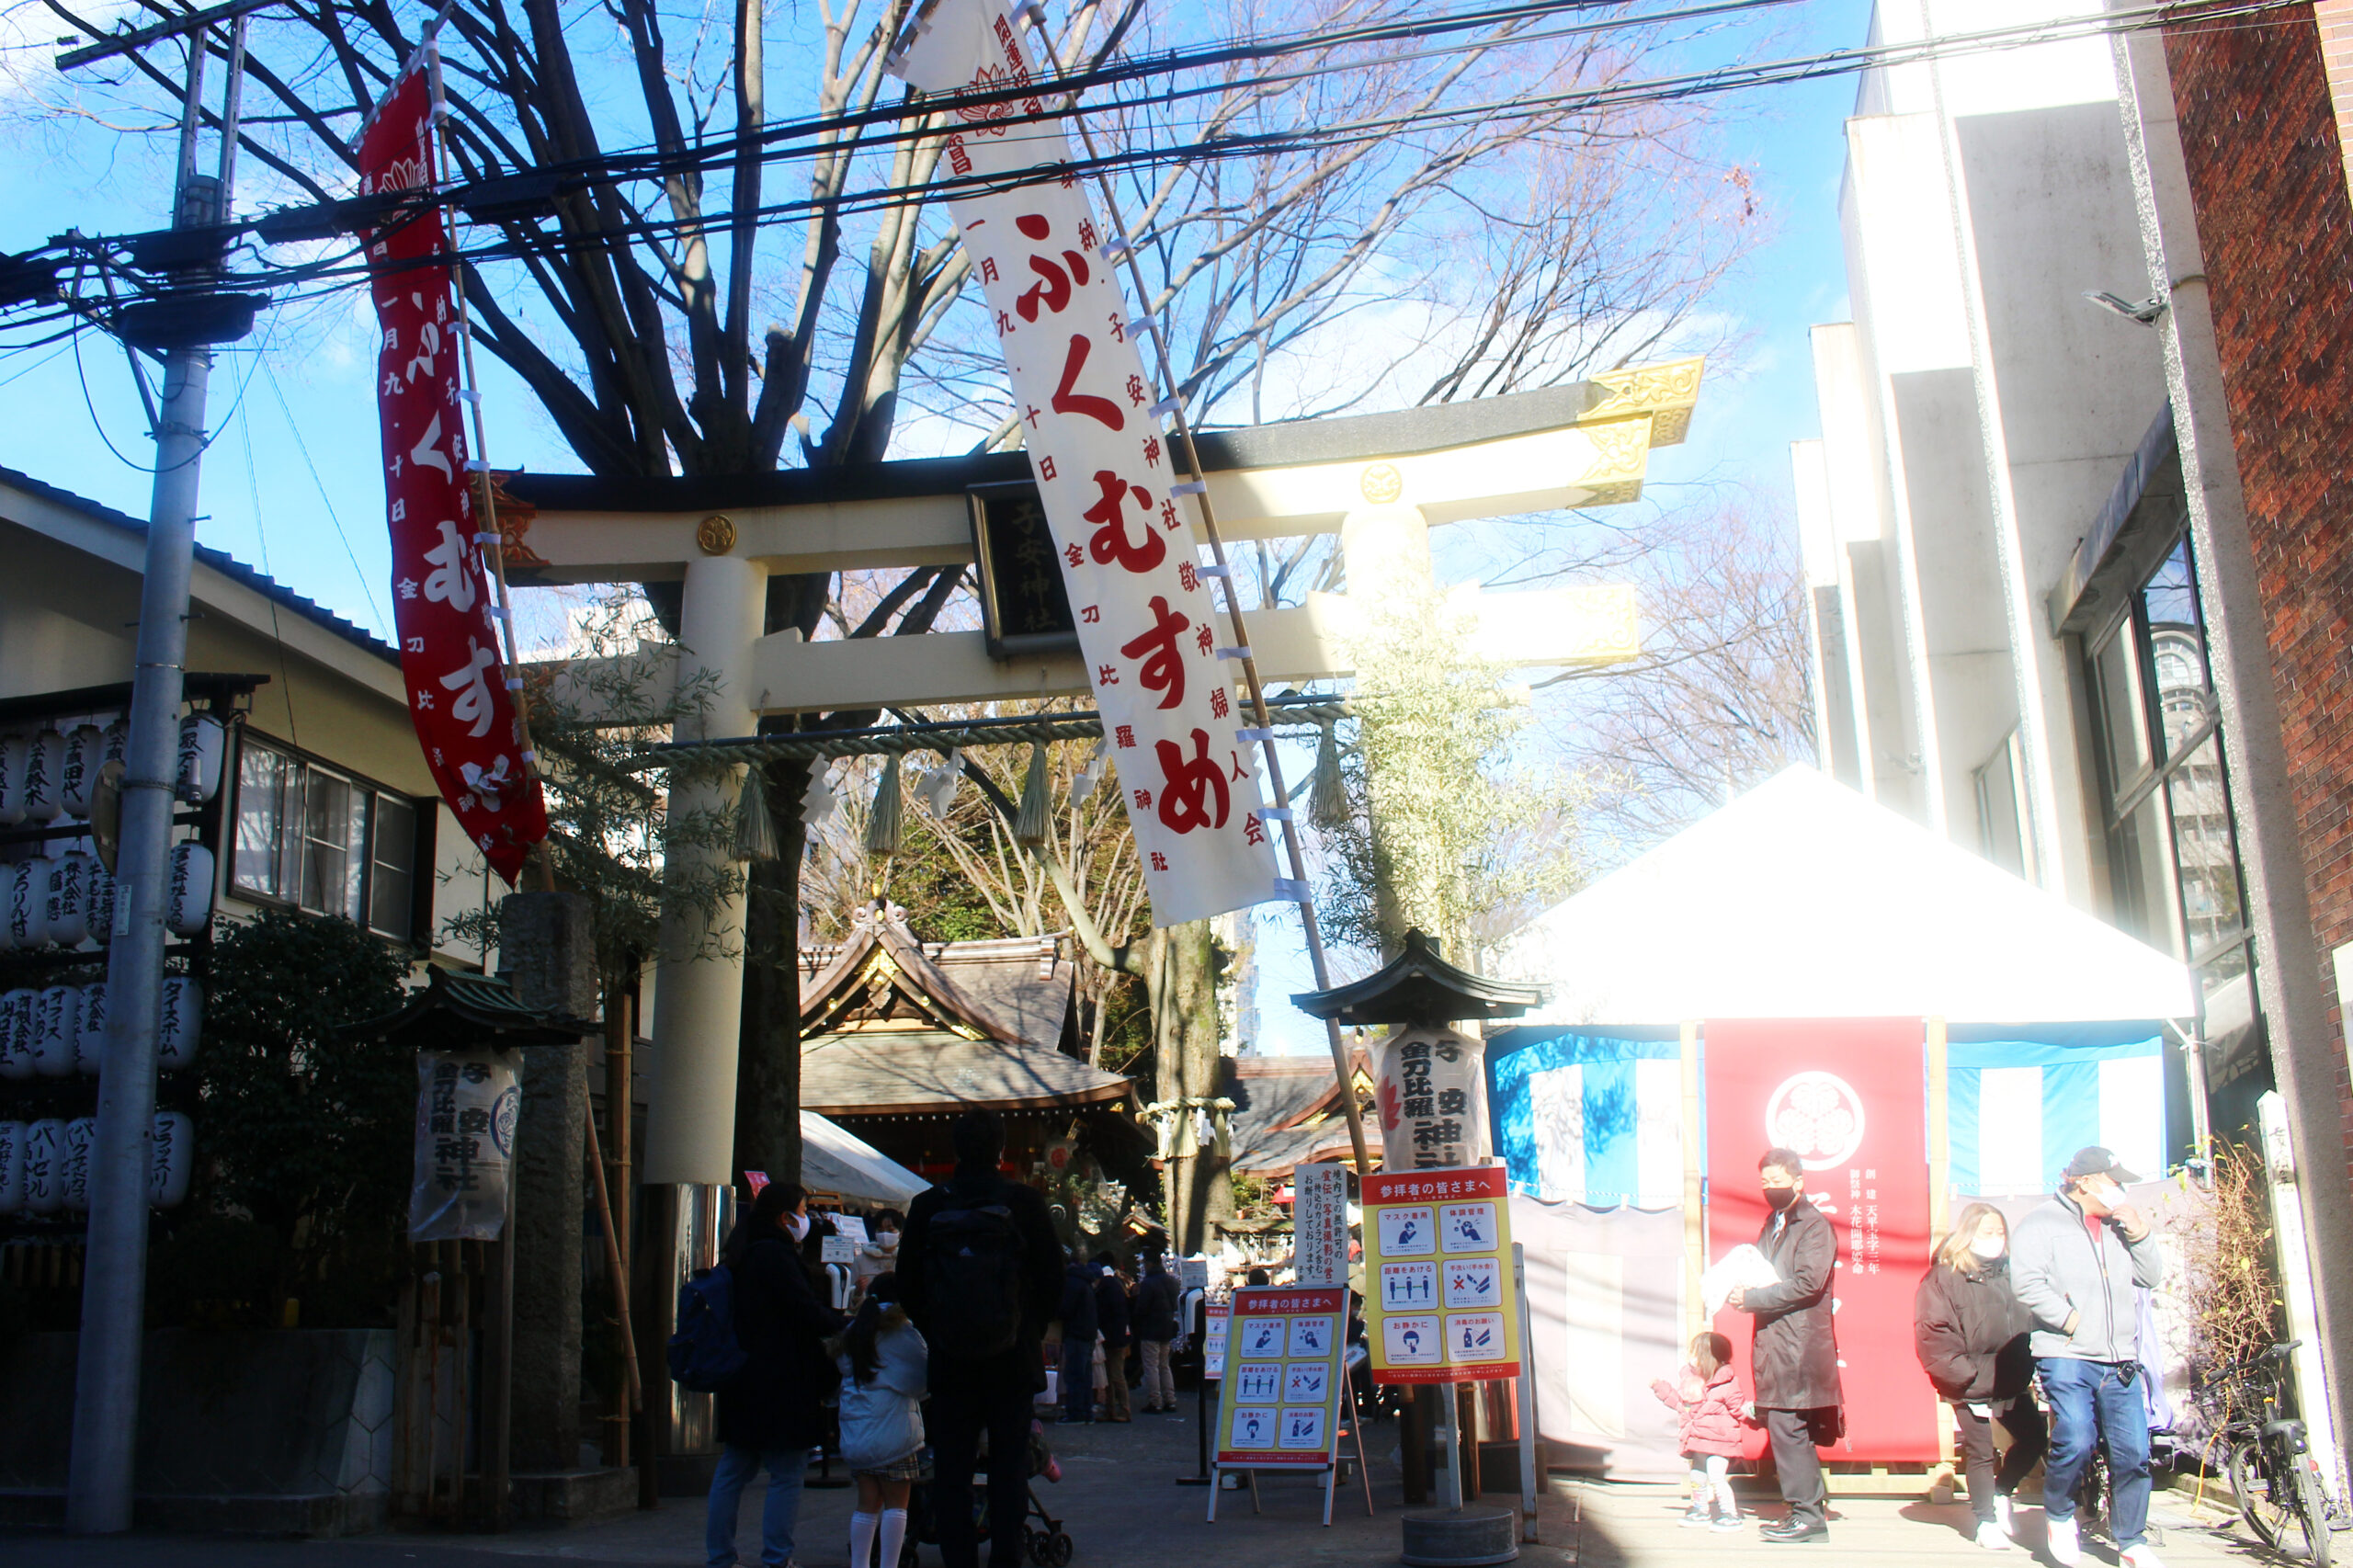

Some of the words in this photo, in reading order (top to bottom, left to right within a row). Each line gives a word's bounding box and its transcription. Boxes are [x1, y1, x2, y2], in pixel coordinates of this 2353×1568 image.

[1016, 212, 1231, 835] ふくむすめ
[1013, 502, 1059, 632] 子安神社
[1064, 541, 1169, 872] 金刀比羅神社
[63, 861, 82, 915] 株式会社
[45, 989, 66, 1040] オフィス
[1400, 1040, 1436, 1119] 金刀比羅
[29, 1125, 56, 1199] バーゼル
[1380, 1180, 1492, 1199] 参拝者の皆さまへ
[1449, 1207, 1485, 1217] 体調管理
[1322, 1169, 1334, 1284] 宣伝・写真撮影の営
[1383, 1210, 1428, 1221] マスク着用
[1383, 1265, 1433, 1276] 距離をあける
[1247, 1297, 1333, 1310] 参拝者の皆さまへ
[1392, 1320, 1428, 1330] お静かに
[1454, 1316, 1495, 1327] 消毒のお願い
